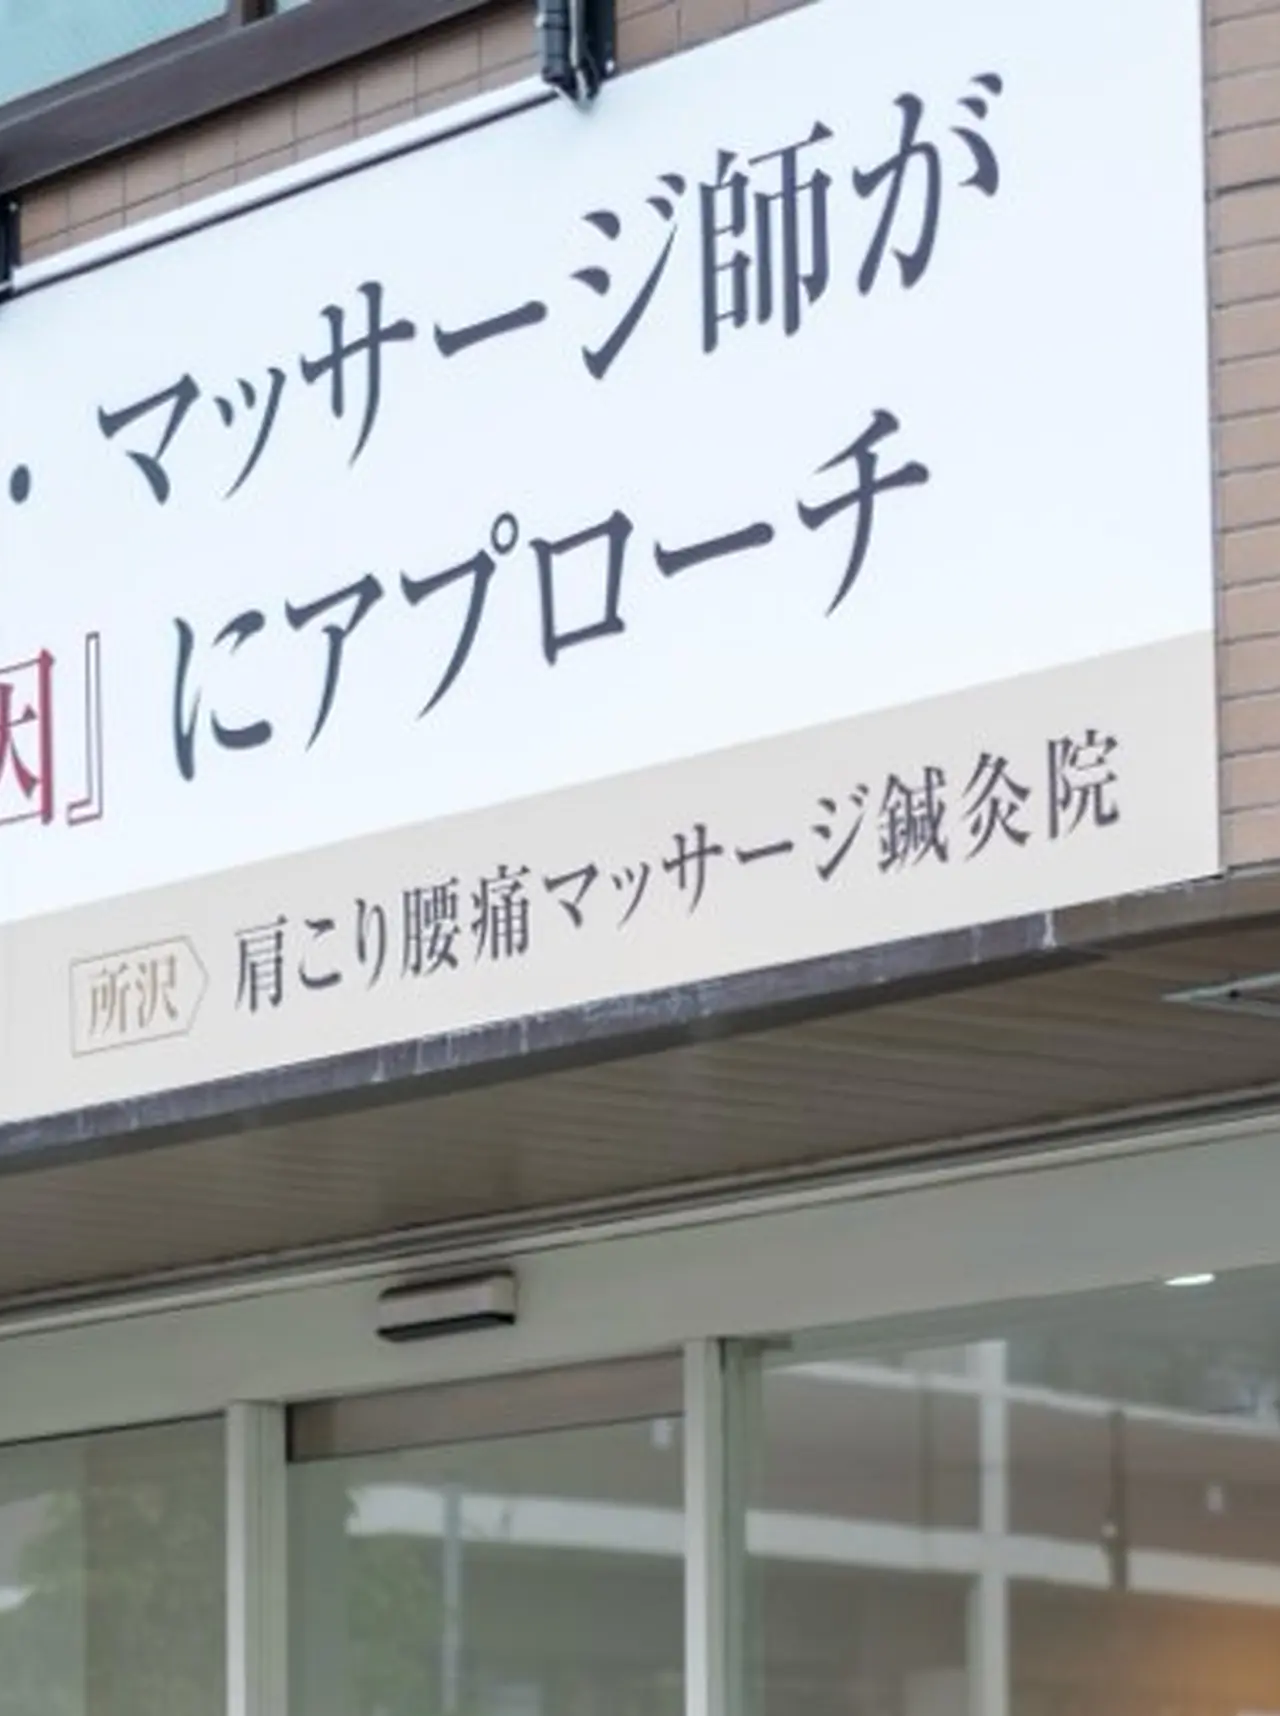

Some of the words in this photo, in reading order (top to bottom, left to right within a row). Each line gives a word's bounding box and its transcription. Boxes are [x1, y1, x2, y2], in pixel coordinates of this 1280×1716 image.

[86, 955, 180, 1039] 所沢
[233, 727, 1122, 1014] 肩こり腰痛マッサージ鍼灸院
